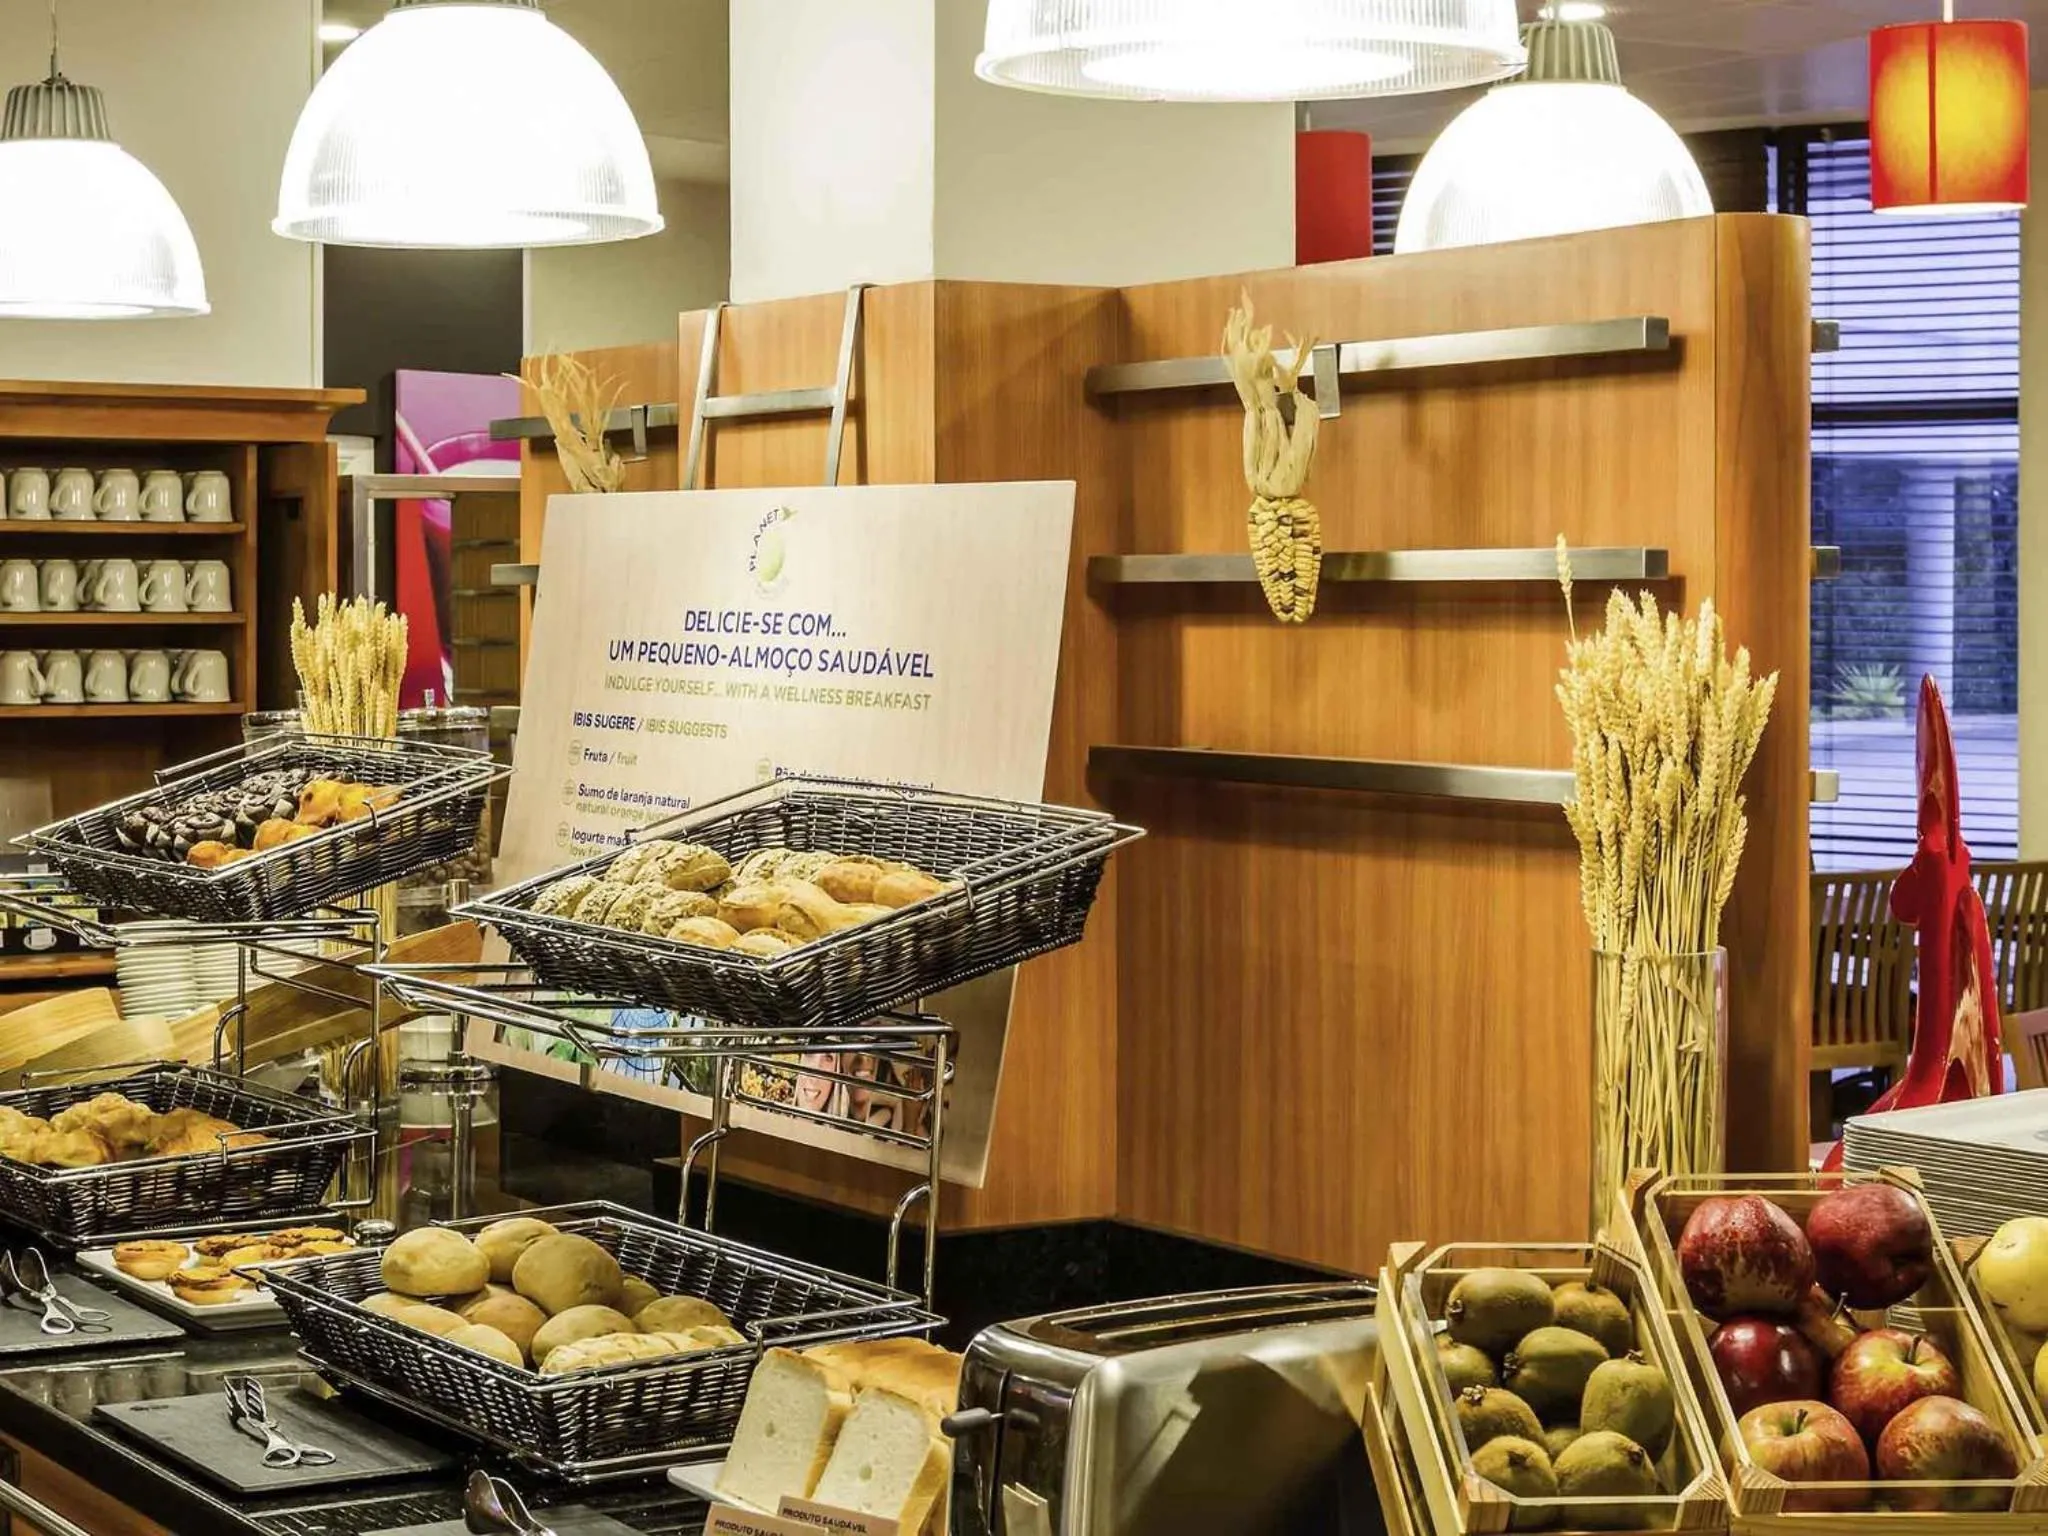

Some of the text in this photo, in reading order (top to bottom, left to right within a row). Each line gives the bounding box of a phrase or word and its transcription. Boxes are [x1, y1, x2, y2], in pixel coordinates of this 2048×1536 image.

[684, 610, 847, 637] DELICIE-SE COM...
[609, 640, 934, 678] UM PEQUENO-ALMOÇO SAUDÁVEL
[604, 674, 653, 692] INDULGE
[725, 682, 758, 699] WITH
[760, 686, 770, 699] A
[774, 686, 843, 705] WELLNESS
[845, 689, 932, 711] BREAKFAST
[573, 712, 593, 727] IBIS
[594, 713, 637, 731] SUGERE
[646, 718, 666, 734] IBIS
[668, 720, 728, 739] SUGGESTS
[583, 747, 608, 763] Fruta
[617, 752, 638, 766] fruit
[578, 783, 691, 809] Sumo de laranja natural
[576, 801, 608, 817] natural
[610, 807, 645, 823] orange
[572, 827, 606, 845] Iogurte
[714, 1519, 753, 1536] PRODUTO
[782, 1508, 821, 1523] PRODUTO
[822, 1516, 867, 1533] SAUDÁVEL
